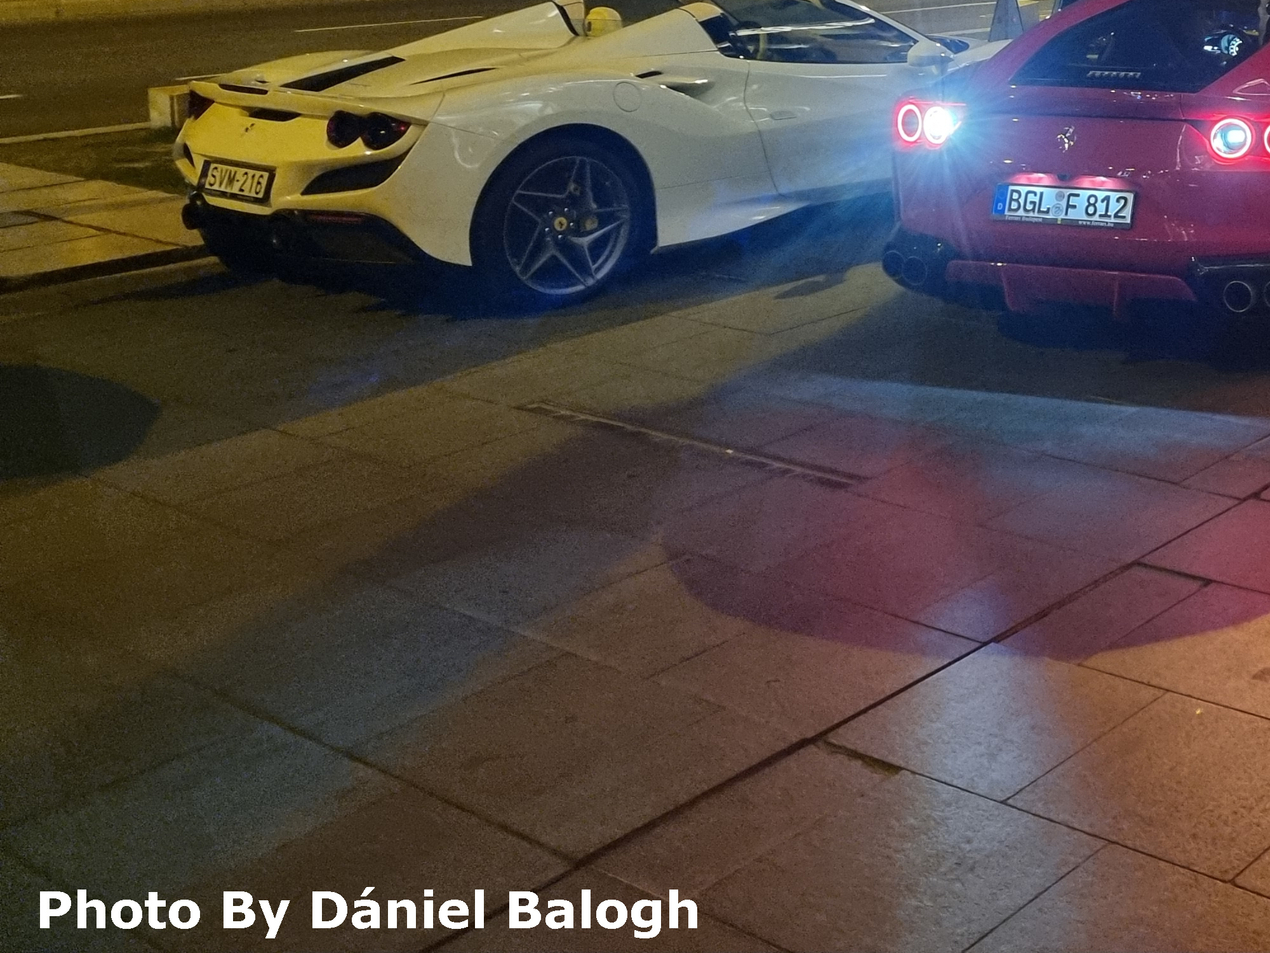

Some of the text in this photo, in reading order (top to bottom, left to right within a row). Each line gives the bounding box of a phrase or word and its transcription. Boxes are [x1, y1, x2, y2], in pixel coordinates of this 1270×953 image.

[208, 167, 264, 196] SVM-216
[1007, 189, 1050, 215] BGL
[1065, 193, 1080, 216] F
[1085, 194, 1128, 219] 812
